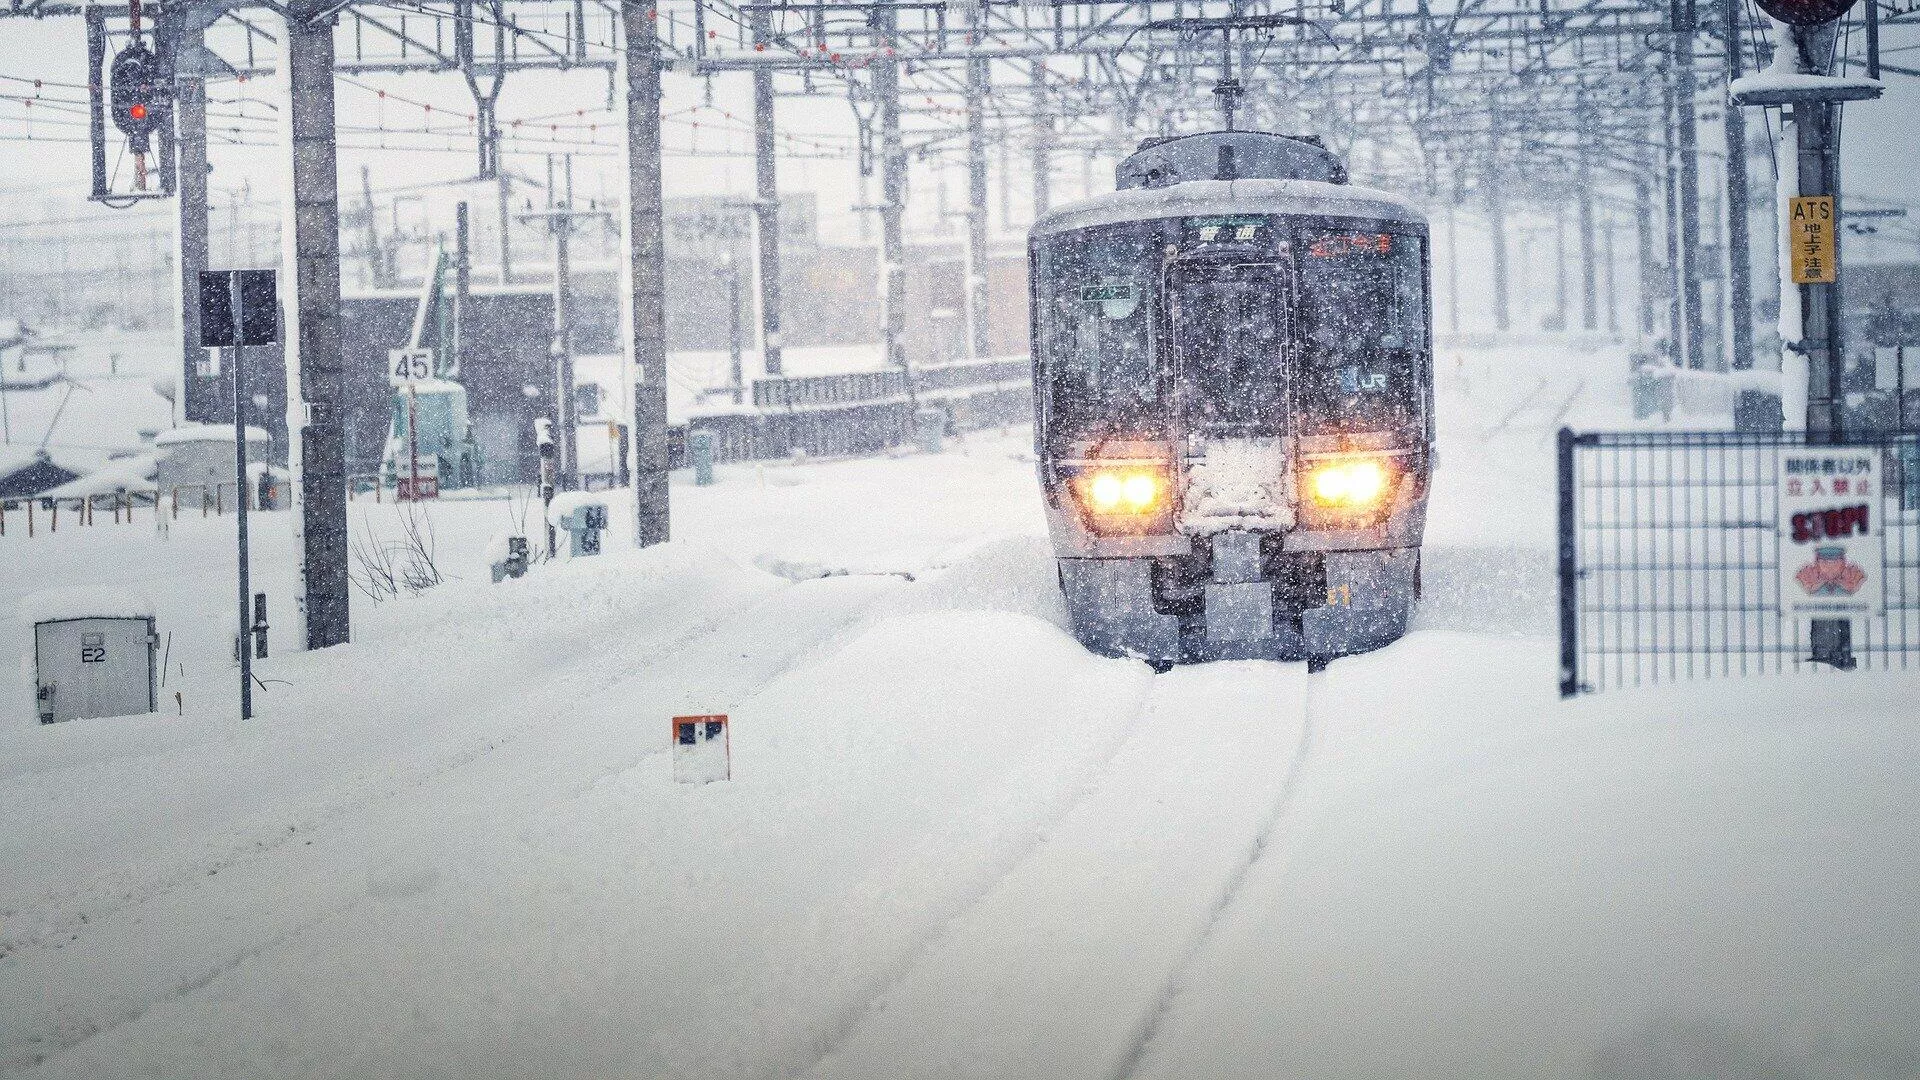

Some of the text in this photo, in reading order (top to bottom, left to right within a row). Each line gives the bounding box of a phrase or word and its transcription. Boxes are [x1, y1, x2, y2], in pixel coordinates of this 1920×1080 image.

[1794, 201, 1829, 220] ATS
[1803, 223, 1822, 279] 地上子注意
[395, 354, 428, 379] 45
[1361, 374, 1386, 389] JR
[82, 648, 105, 663] E2
